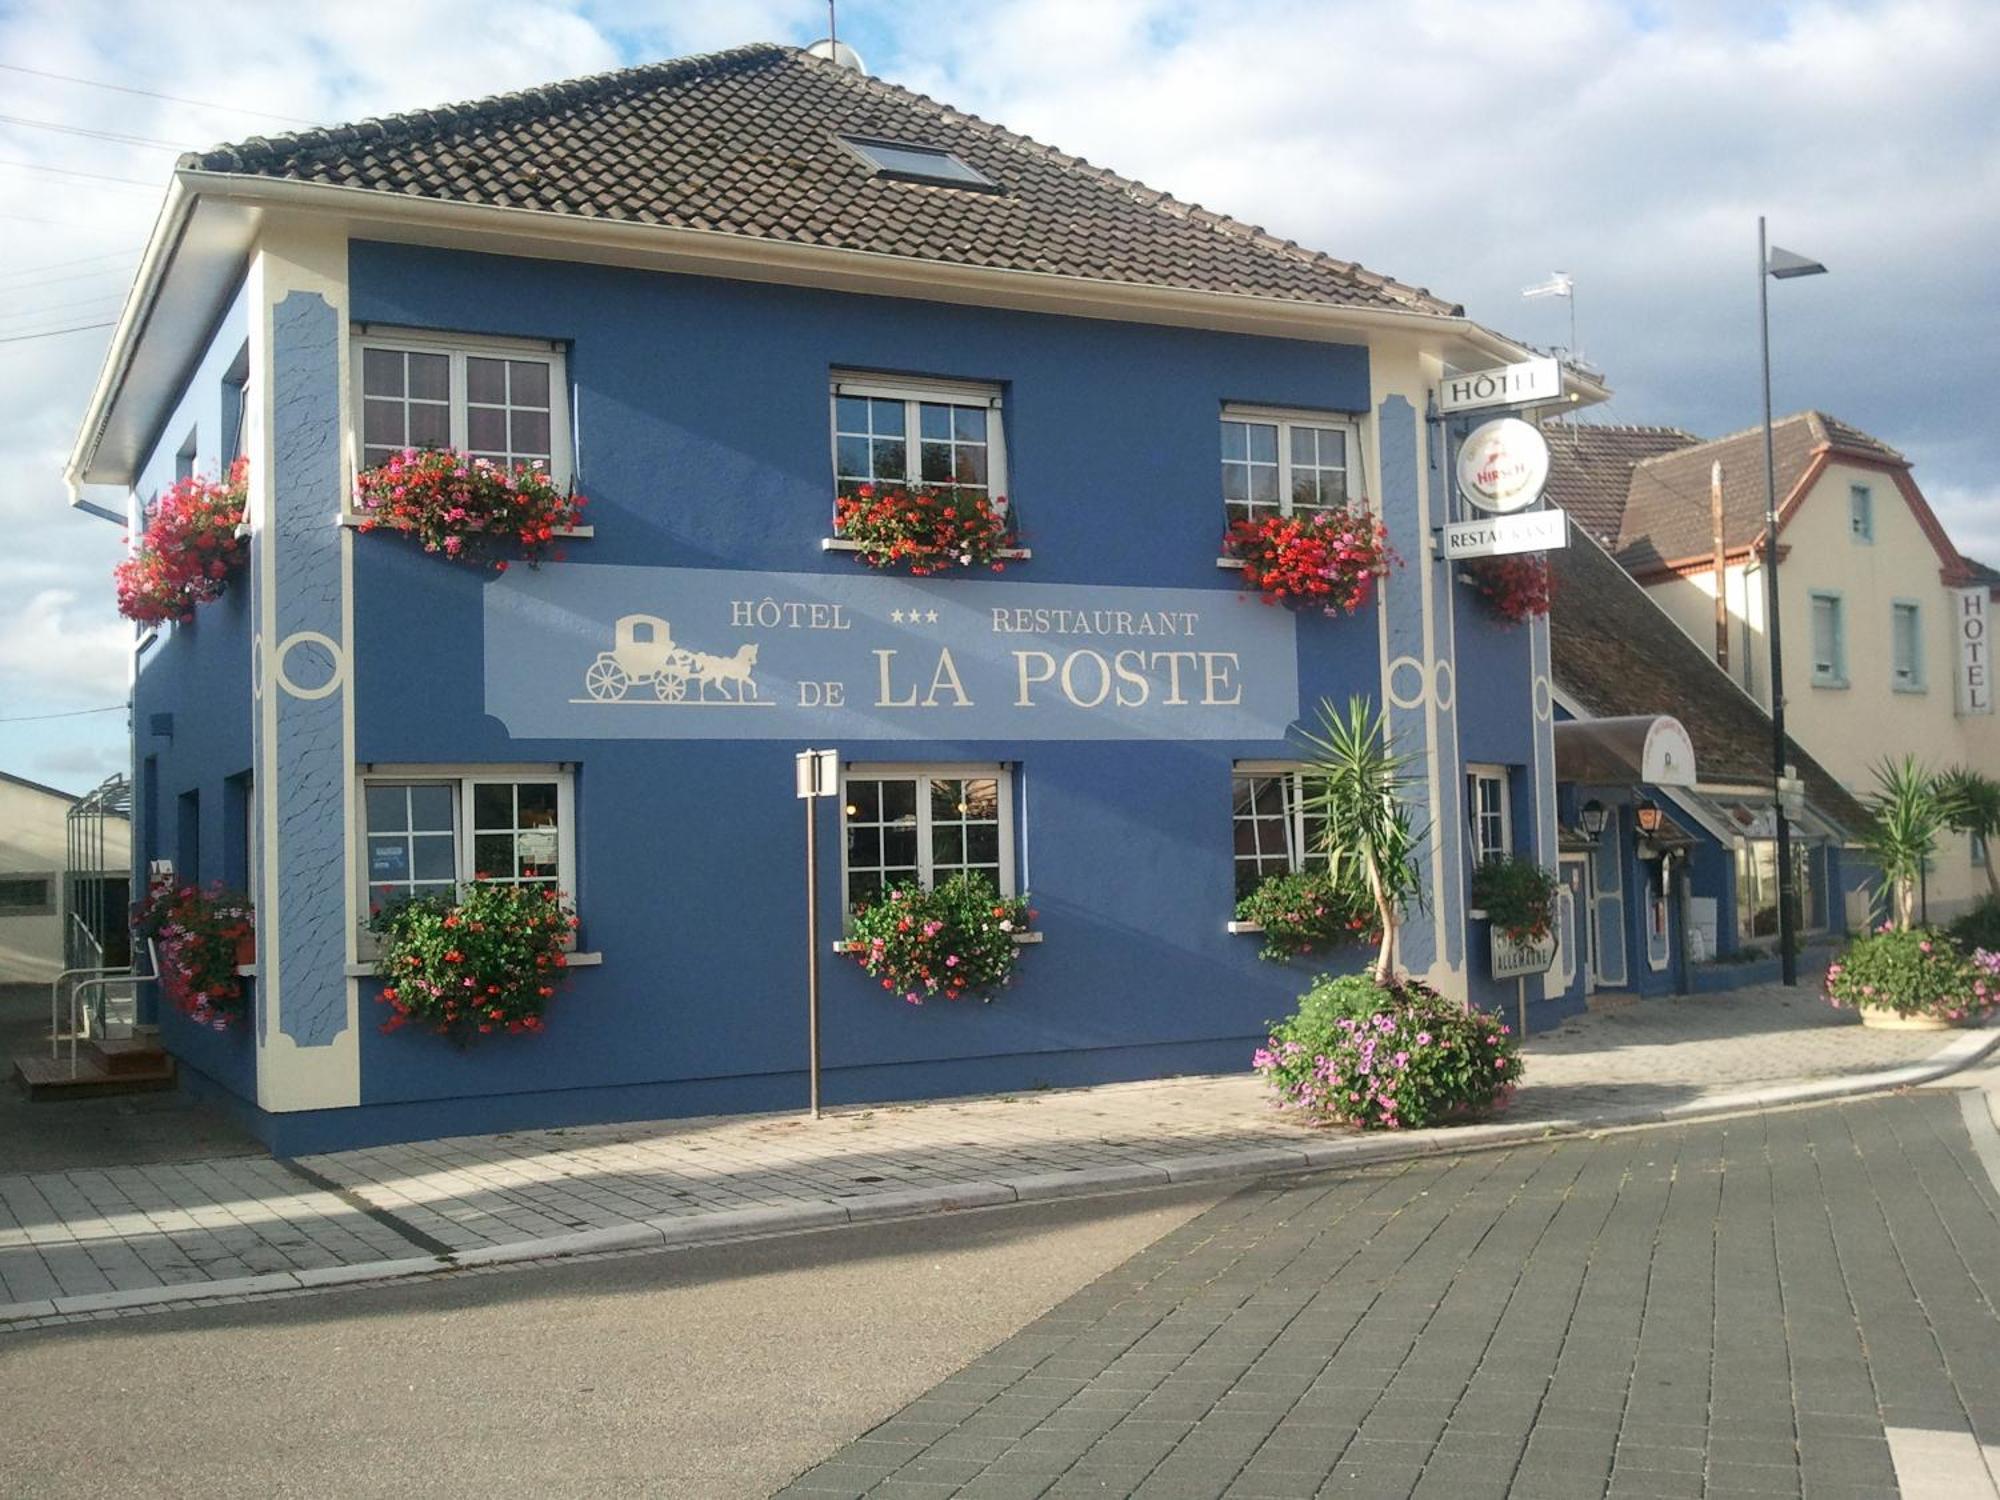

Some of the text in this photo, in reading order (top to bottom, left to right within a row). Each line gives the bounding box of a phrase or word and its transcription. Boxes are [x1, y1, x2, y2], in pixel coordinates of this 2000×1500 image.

[1477, 463, 1525, 485] HIRH
[1451, 521, 1554, 548] RESTA
[730, 597, 1199, 637] HÔTEL RESTAURANT
[1963, 595, 1985, 708] HOTEL
[797, 647, 1243, 709] DE LA POSTE
